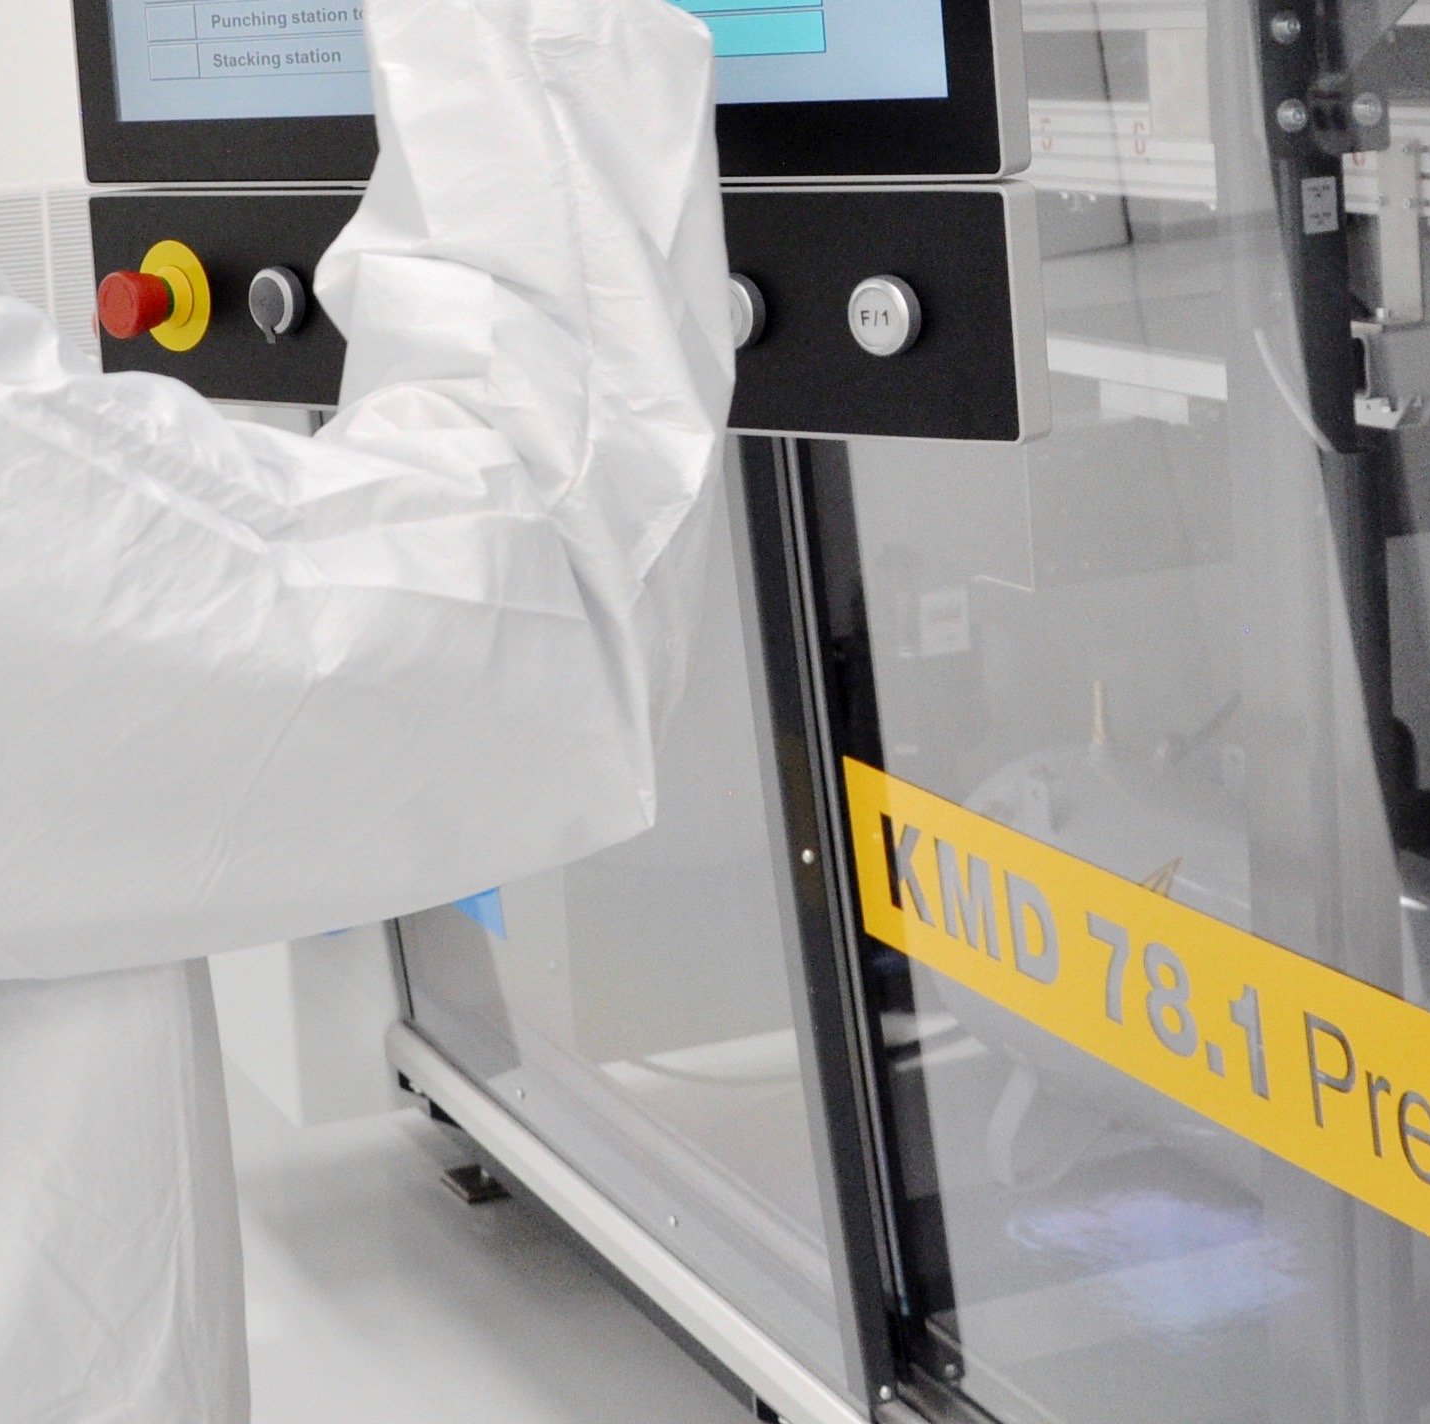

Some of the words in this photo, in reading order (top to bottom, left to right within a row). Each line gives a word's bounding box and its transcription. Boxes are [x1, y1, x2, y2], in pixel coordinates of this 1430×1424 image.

[211, 10, 287, 30] Punching
[291, 6, 348, 25] station
[213, 50, 282, 70] Stacking
[285, 47, 342, 66] station
[879, 812, 1061, 988] KMD
[1084, 909, 1273, 1103] 78.1
